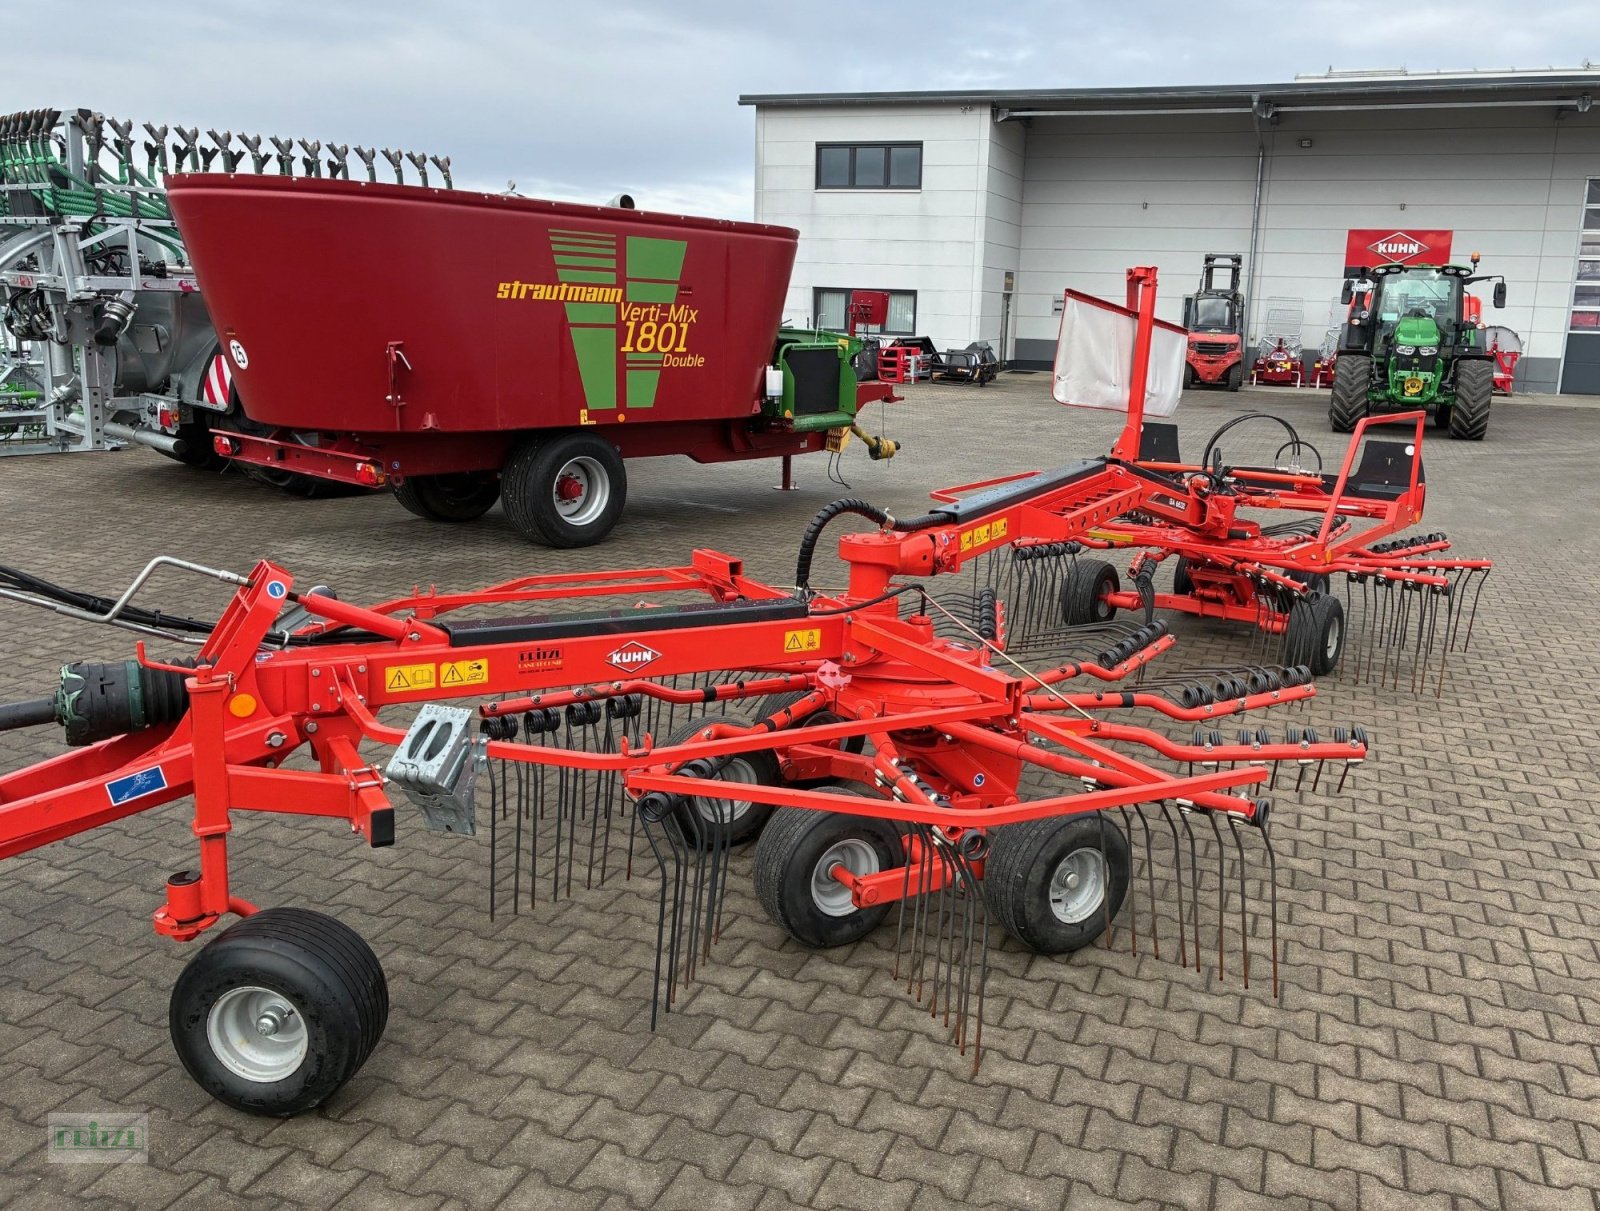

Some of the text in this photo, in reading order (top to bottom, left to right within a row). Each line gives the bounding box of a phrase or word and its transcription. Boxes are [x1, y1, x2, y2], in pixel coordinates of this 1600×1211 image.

[1377, 243, 1419, 254] KUHN
[496, 280, 624, 303] strautmann
[620, 301, 698, 323] Verti-Mix
[620, 321, 689, 353] 1801
[231, 344, 246, 364] 25
[662, 353, 705, 368] Double
[611, 650, 652, 664] KUHN
